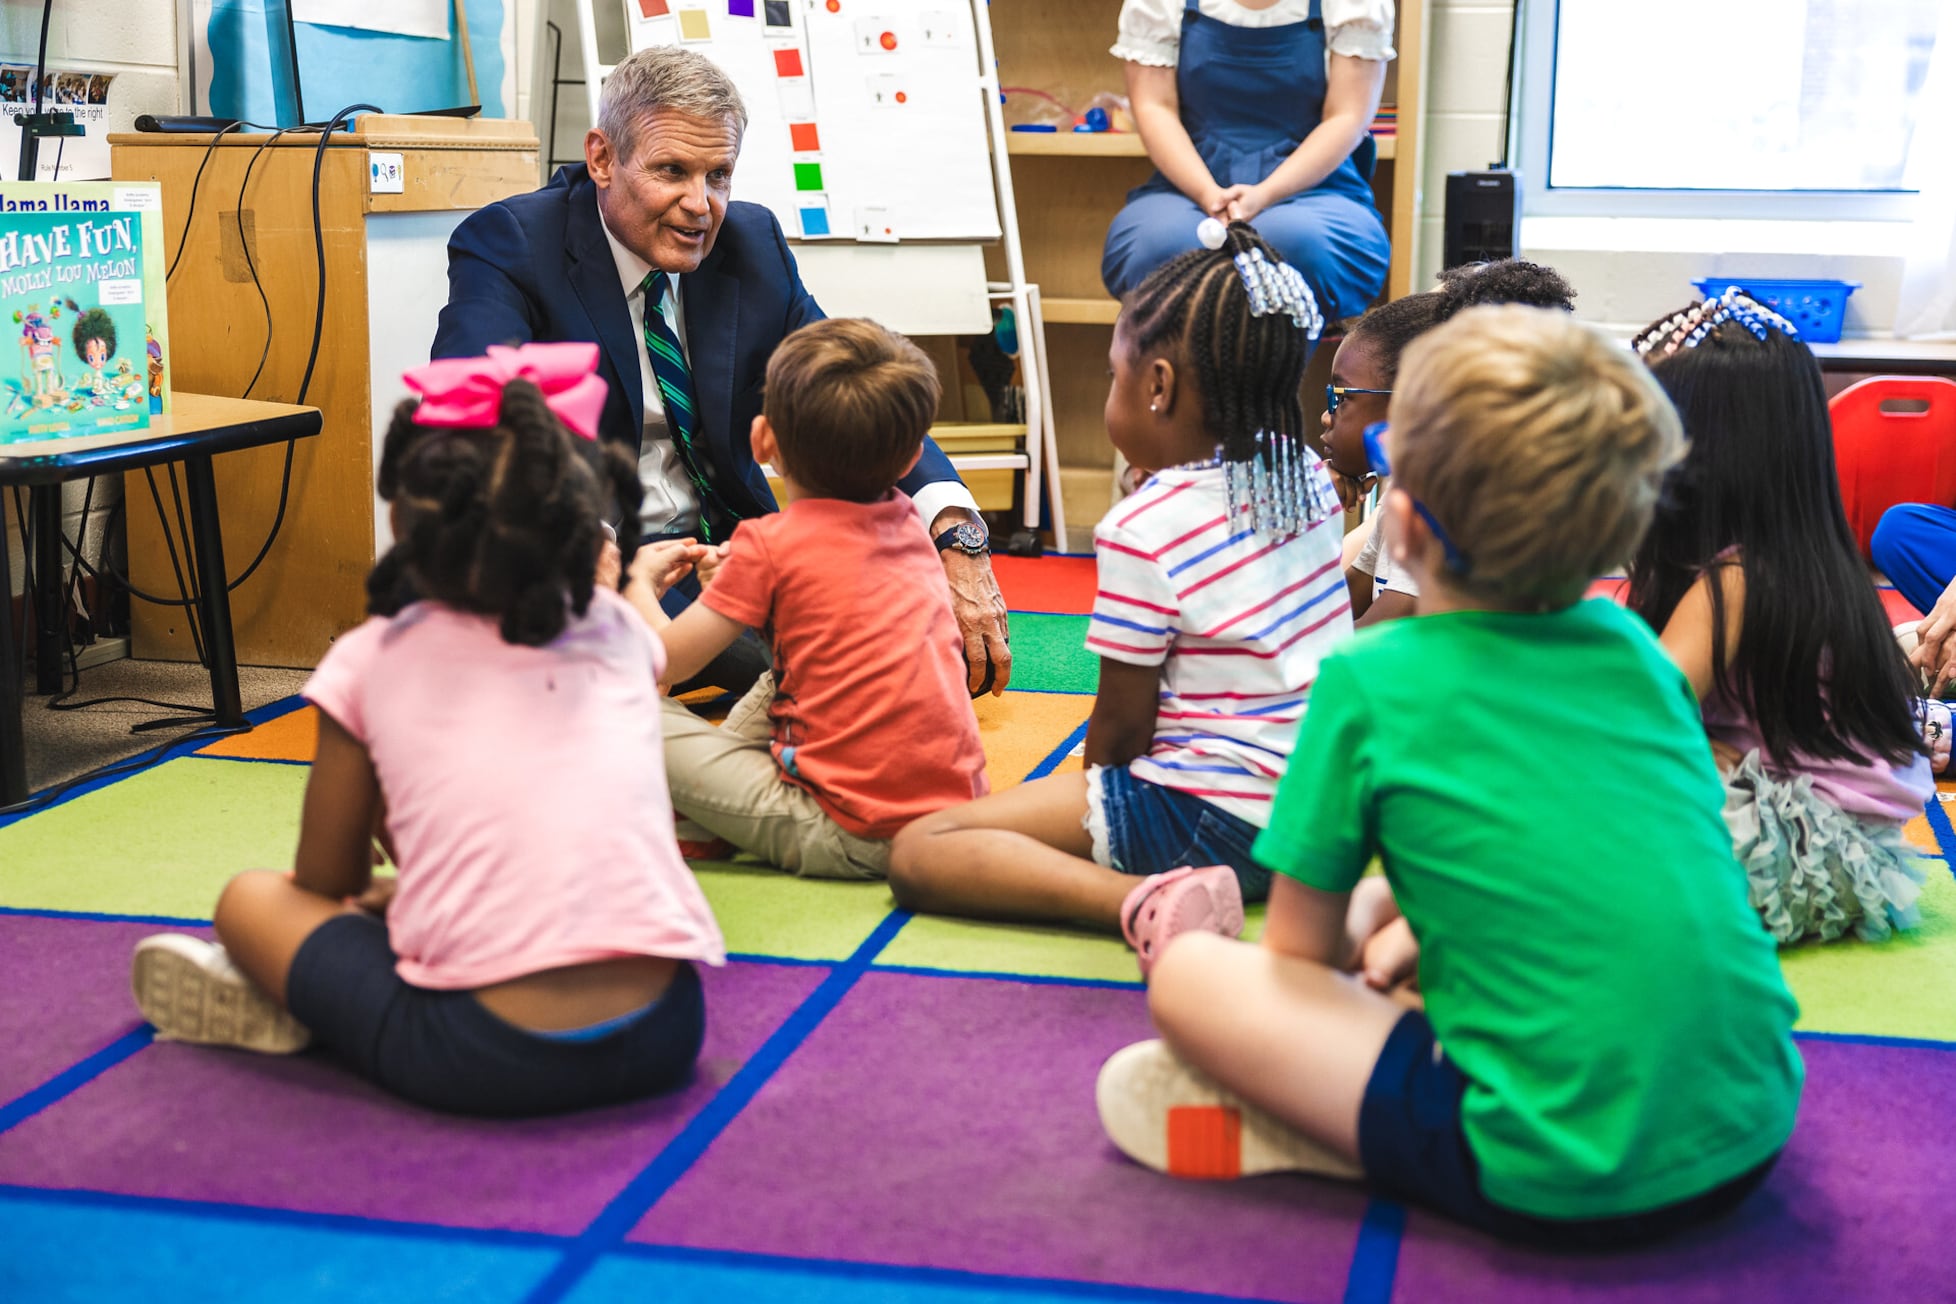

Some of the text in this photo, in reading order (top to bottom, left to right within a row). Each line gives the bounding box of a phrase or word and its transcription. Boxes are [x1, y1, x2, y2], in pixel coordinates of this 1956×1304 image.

[75, 106, 86, 118] the
[88, 106, 103, 121] right
[0, 194, 110, 212] lama llama
[0, 217, 138, 273] HAVE FUN,
[2, 258, 136, 299] MOLLY LOU MELON
